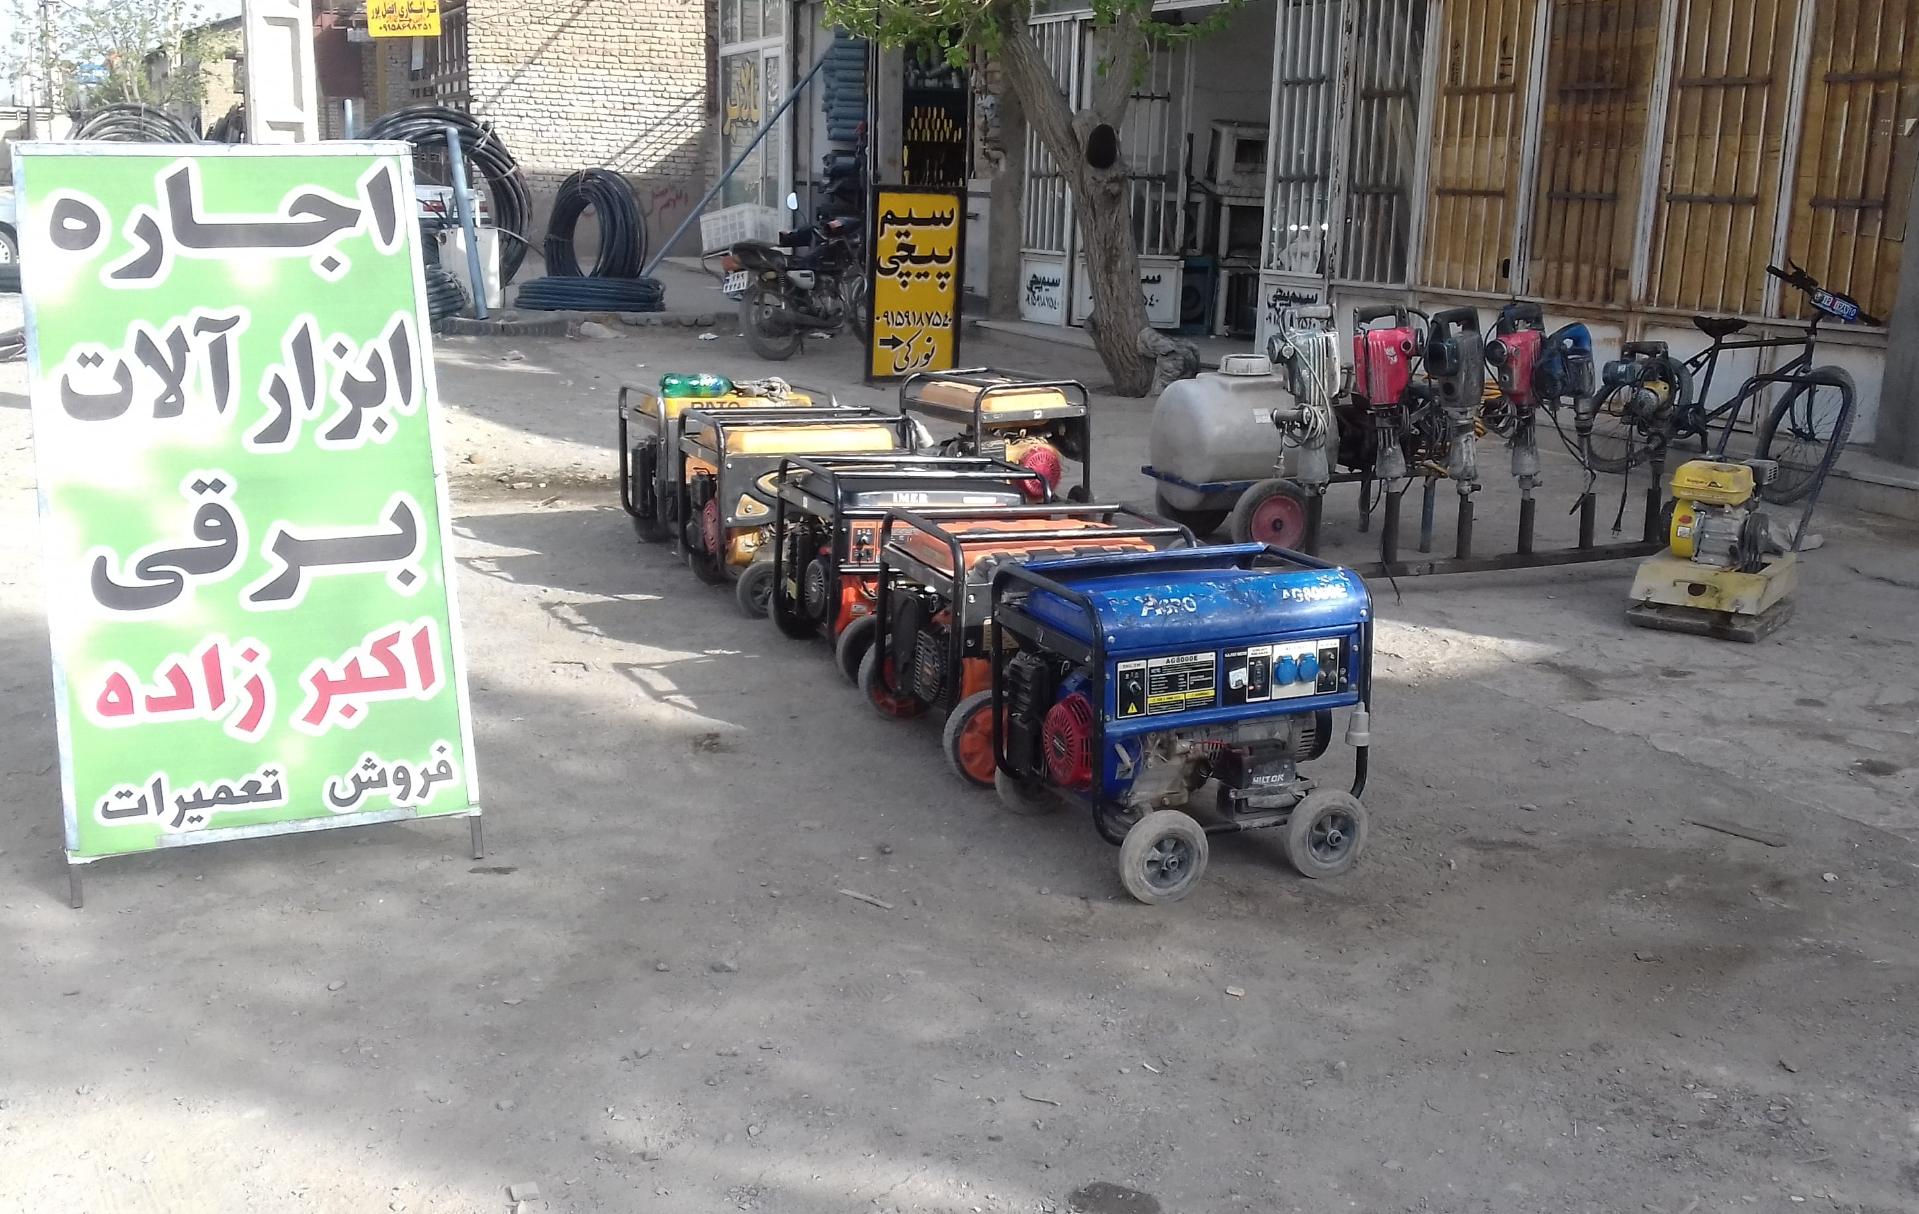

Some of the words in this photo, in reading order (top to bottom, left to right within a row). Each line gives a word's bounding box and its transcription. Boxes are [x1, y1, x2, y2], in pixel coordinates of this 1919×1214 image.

[49, 166, 397, 280] اجاره
[877, 239, 954, 291] پیچی
[879, 207, 955, 239] سیم
[60, 315, 241, 422] آلات
[253, 319, 412, 444] ابزار
[91, 477, 418, 611] برقی
[96, 643, 266, 732] زاده
[302, 625, 436, 726] اکبر
[100, 767, 283, 828] تعمیرات
[328, 745, 454, 806] فروش
